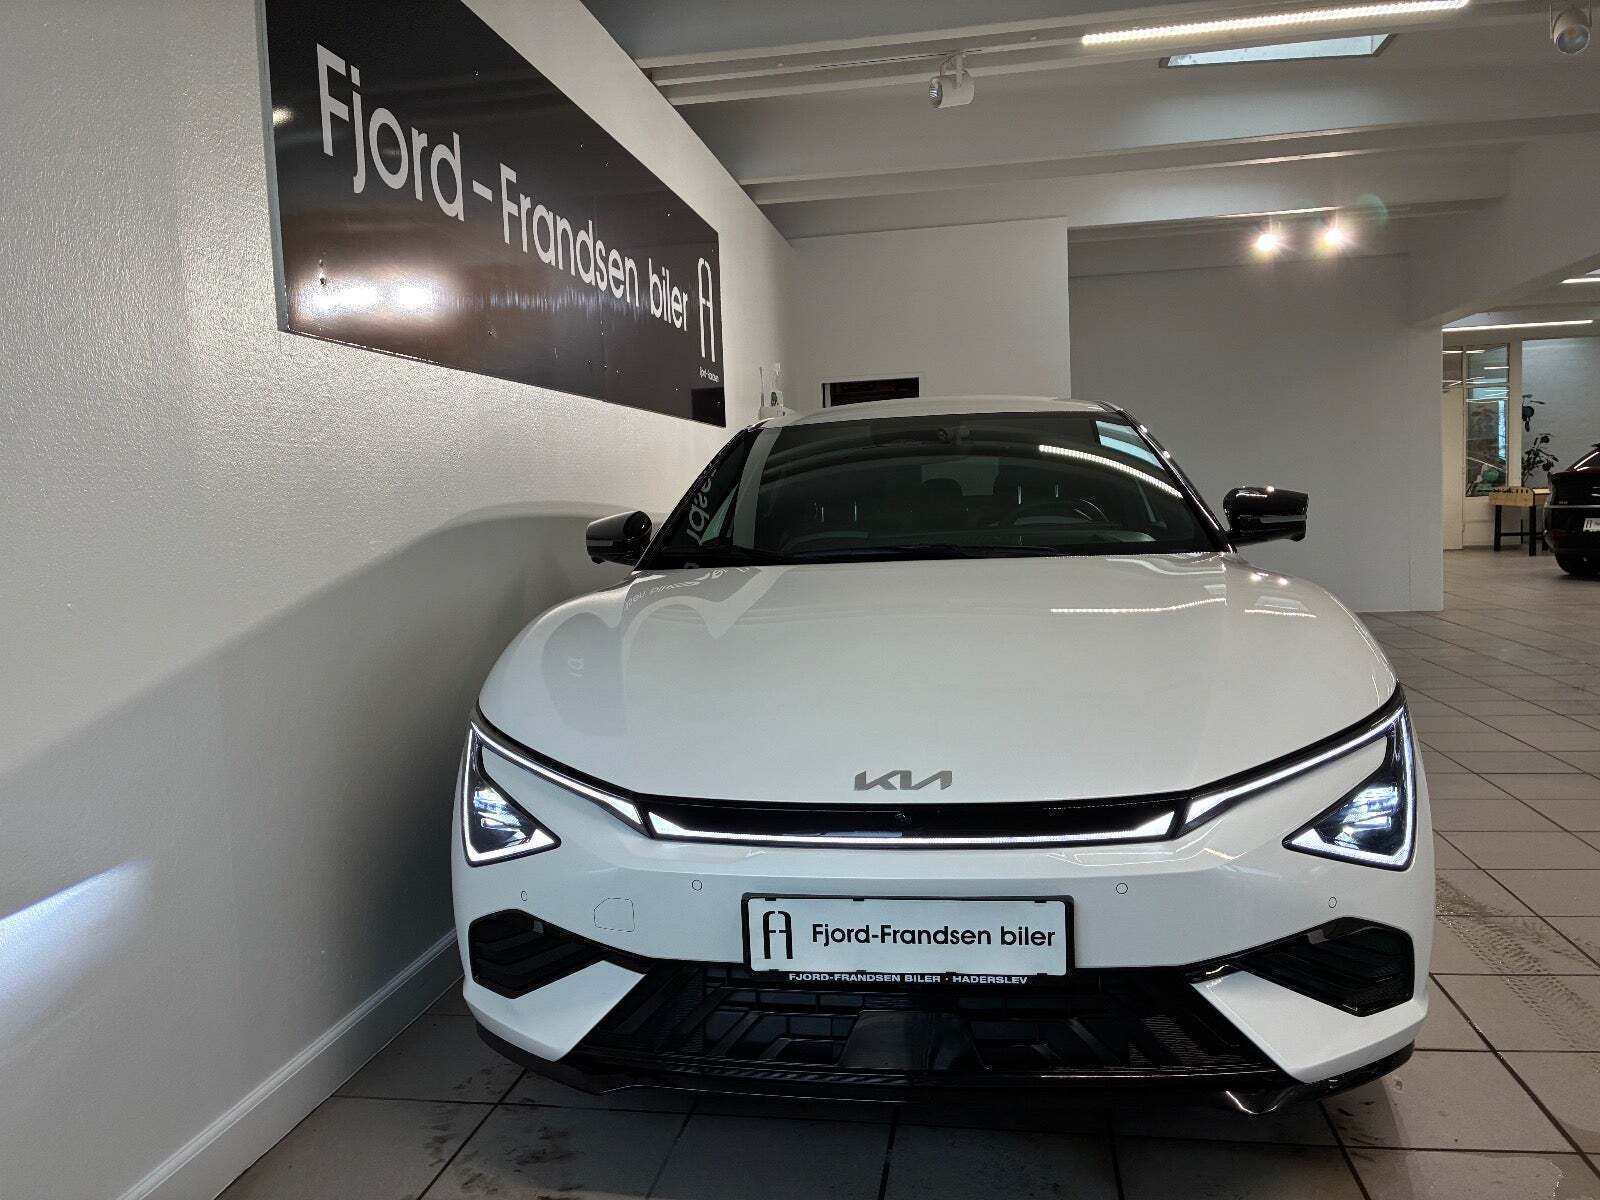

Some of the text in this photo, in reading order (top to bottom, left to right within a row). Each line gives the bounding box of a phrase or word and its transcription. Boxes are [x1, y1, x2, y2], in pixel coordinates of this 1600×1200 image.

[648, 258, 688, 332] biler
[812, 923, 1056, 948] Fjord-Frandsen biler
[789, 973, 1028, 985] FJORD-FRANDSEN BILER HADERSLEV
